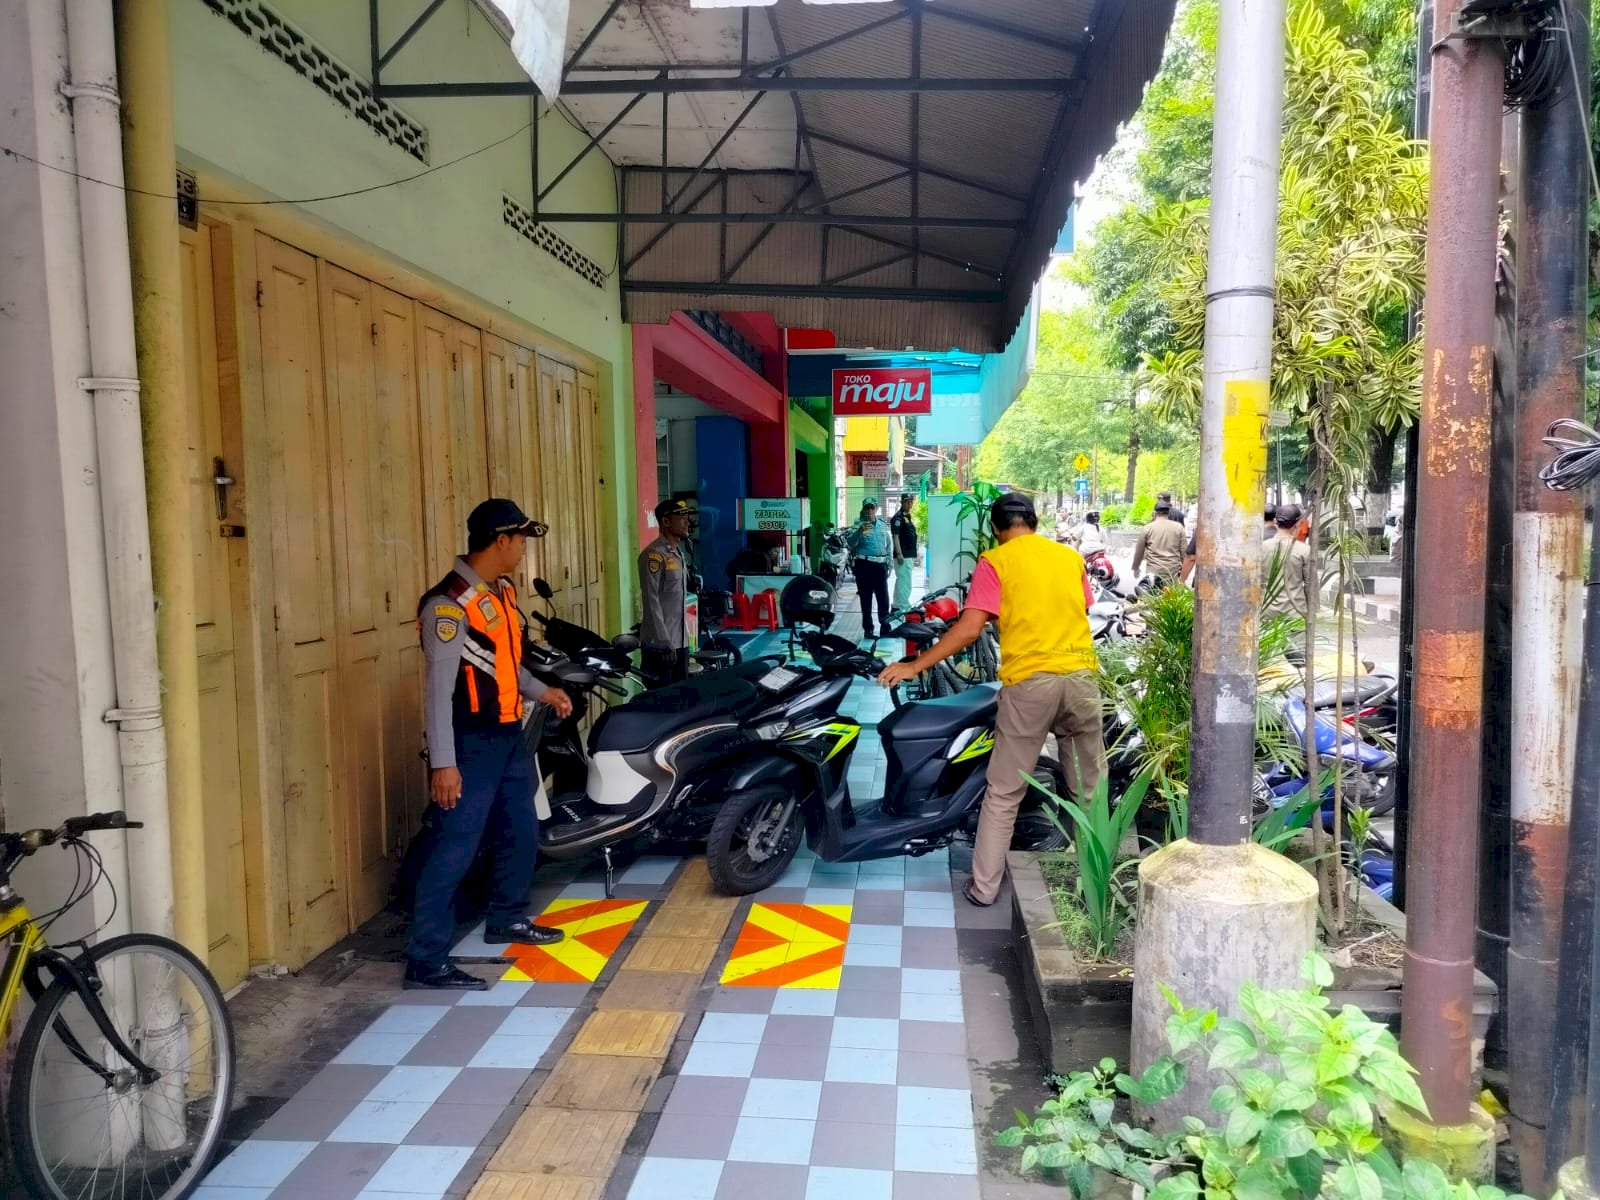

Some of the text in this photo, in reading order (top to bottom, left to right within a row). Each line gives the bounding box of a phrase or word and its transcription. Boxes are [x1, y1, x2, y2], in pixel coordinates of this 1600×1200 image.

[844, 375, 871, 383] TOKO
[839, 378, 925, 408] maju
[755, 510, 791, 518] ZUPPA
[758, 521, 787, 530] SOUP
